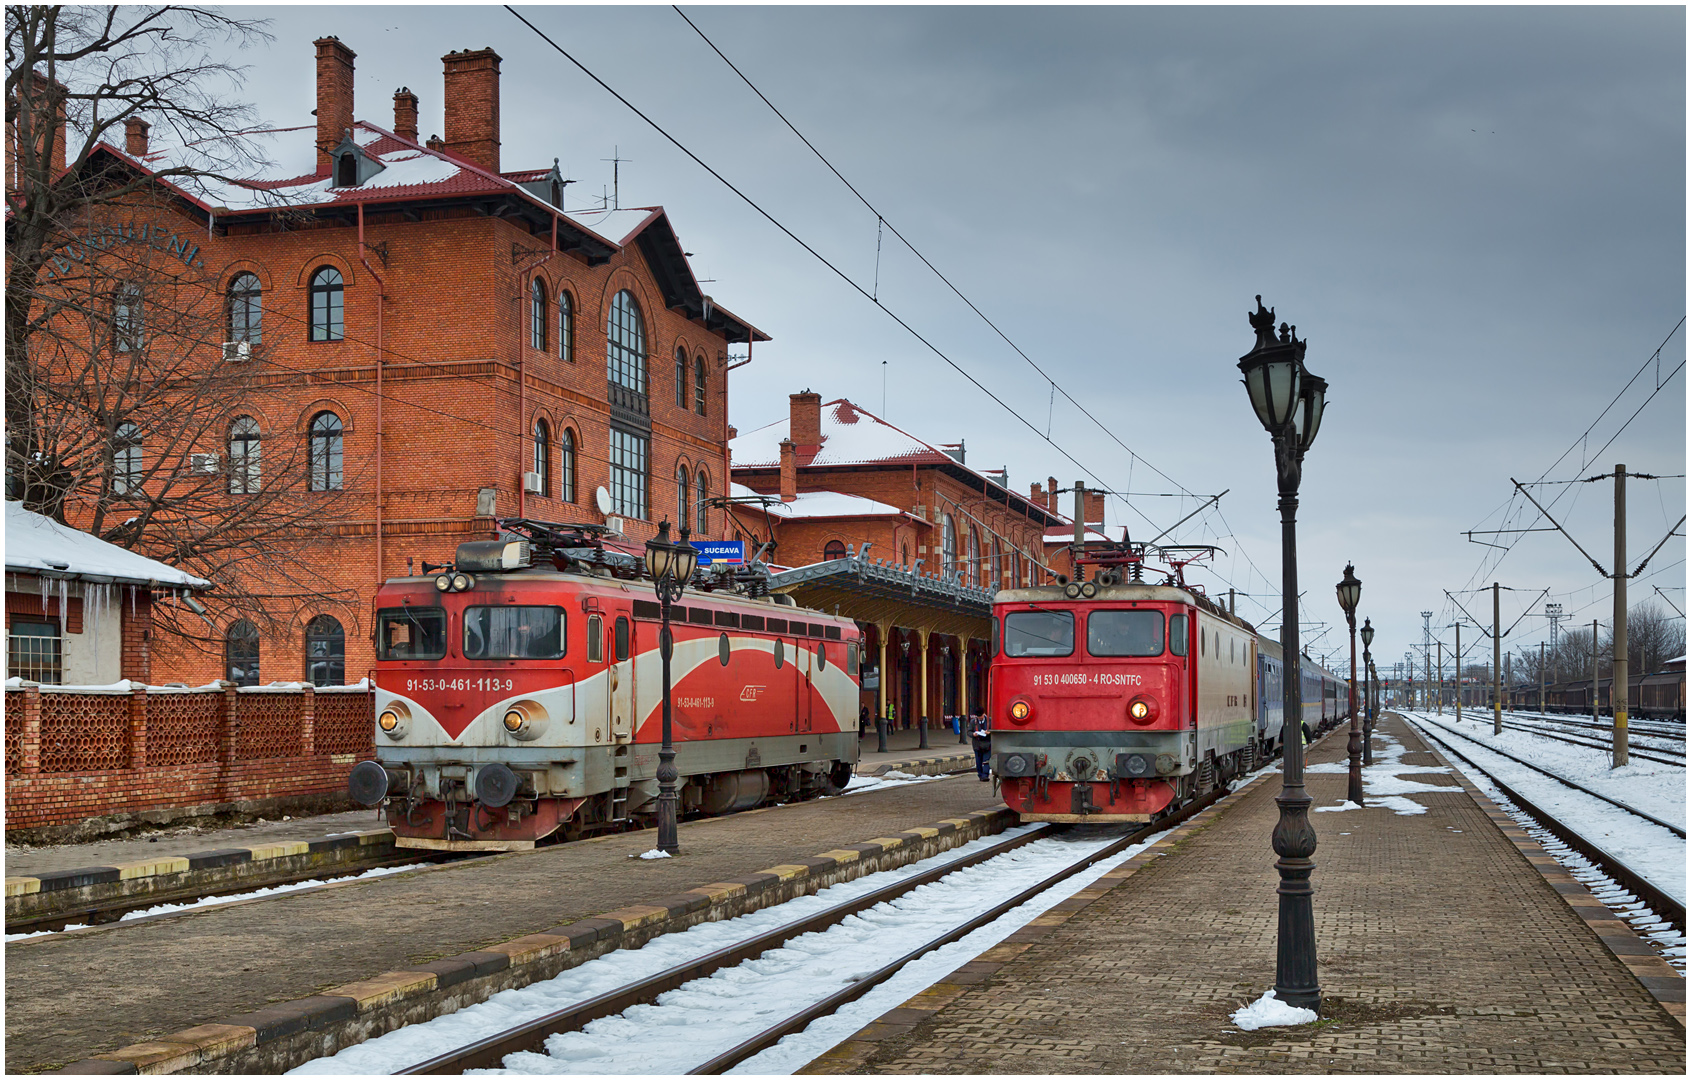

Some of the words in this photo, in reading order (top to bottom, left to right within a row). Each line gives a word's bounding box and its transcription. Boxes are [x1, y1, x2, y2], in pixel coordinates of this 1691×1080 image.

[406, 678, 513, 691] 91-53-0-461-113-9
[1033, 674, 1042, 685] 91
[1044, 674, 1053, 685] 53
[1054, 674, 1059, 685] 0
[1060, 673, 1087, 685] 400650
[1093, 674, 1099, 685] 4
[1100, 673, 1142, 686] RO-SNTFC
[745, 688, 757, 698] CFR
